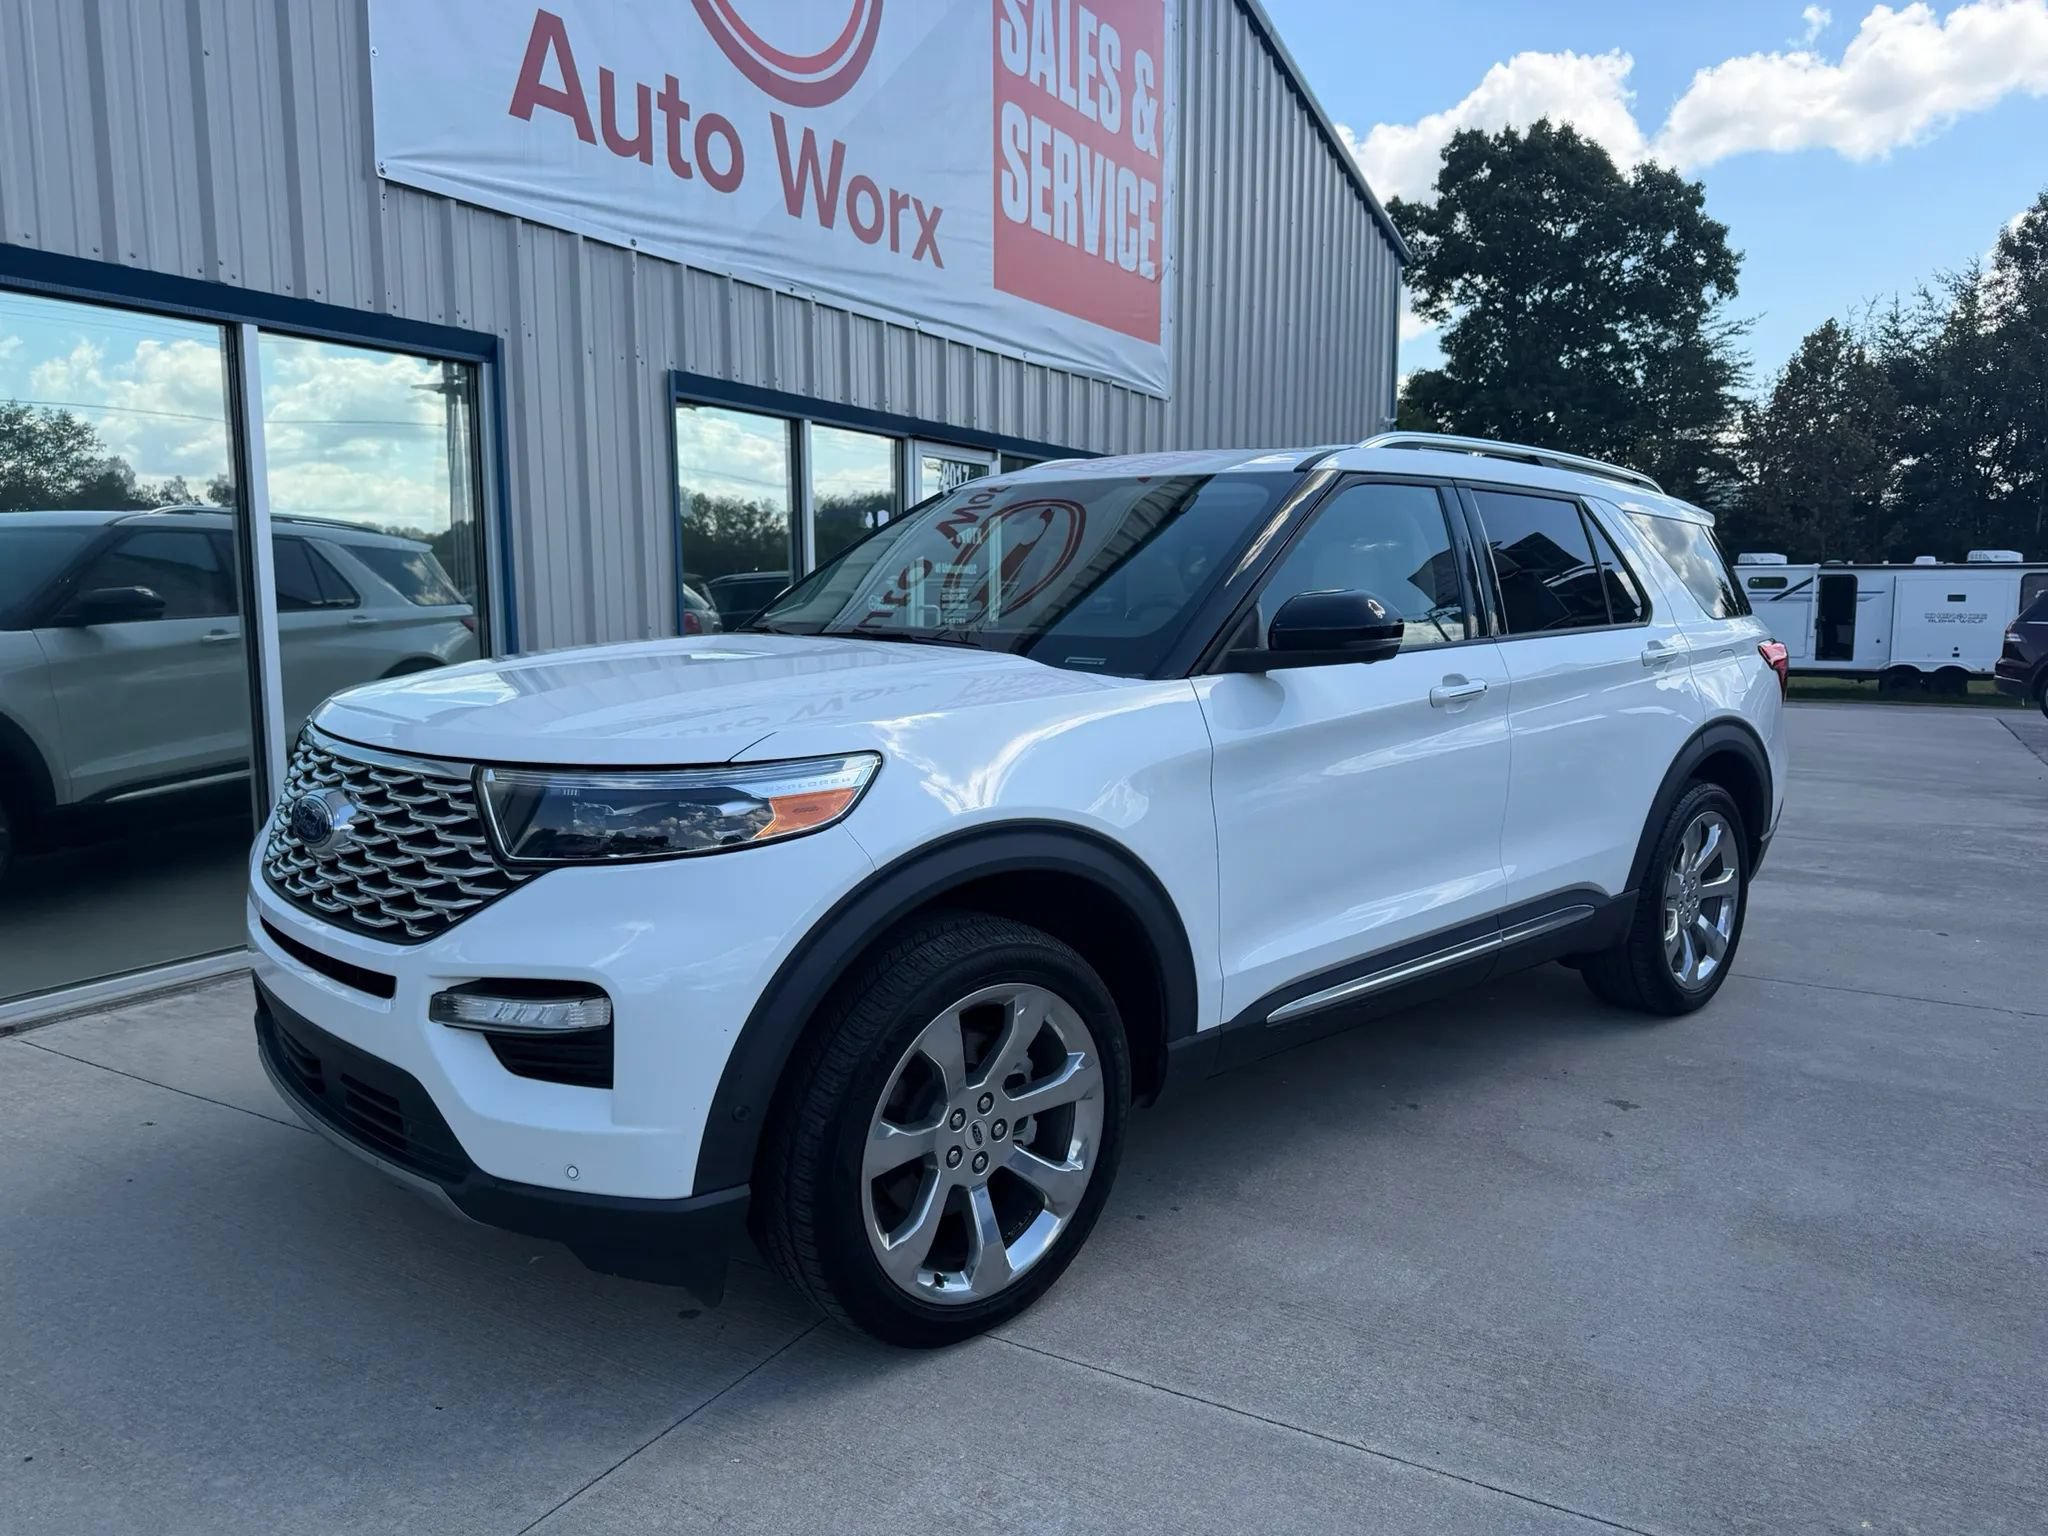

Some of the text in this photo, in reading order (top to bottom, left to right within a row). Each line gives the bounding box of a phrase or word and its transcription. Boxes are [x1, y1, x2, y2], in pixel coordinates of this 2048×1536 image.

[508, 8, 945, 270] Auto Worx
[1000, 0, 1159, 159] SALES &
[1001, 100, 1157, 281] SERVICE
